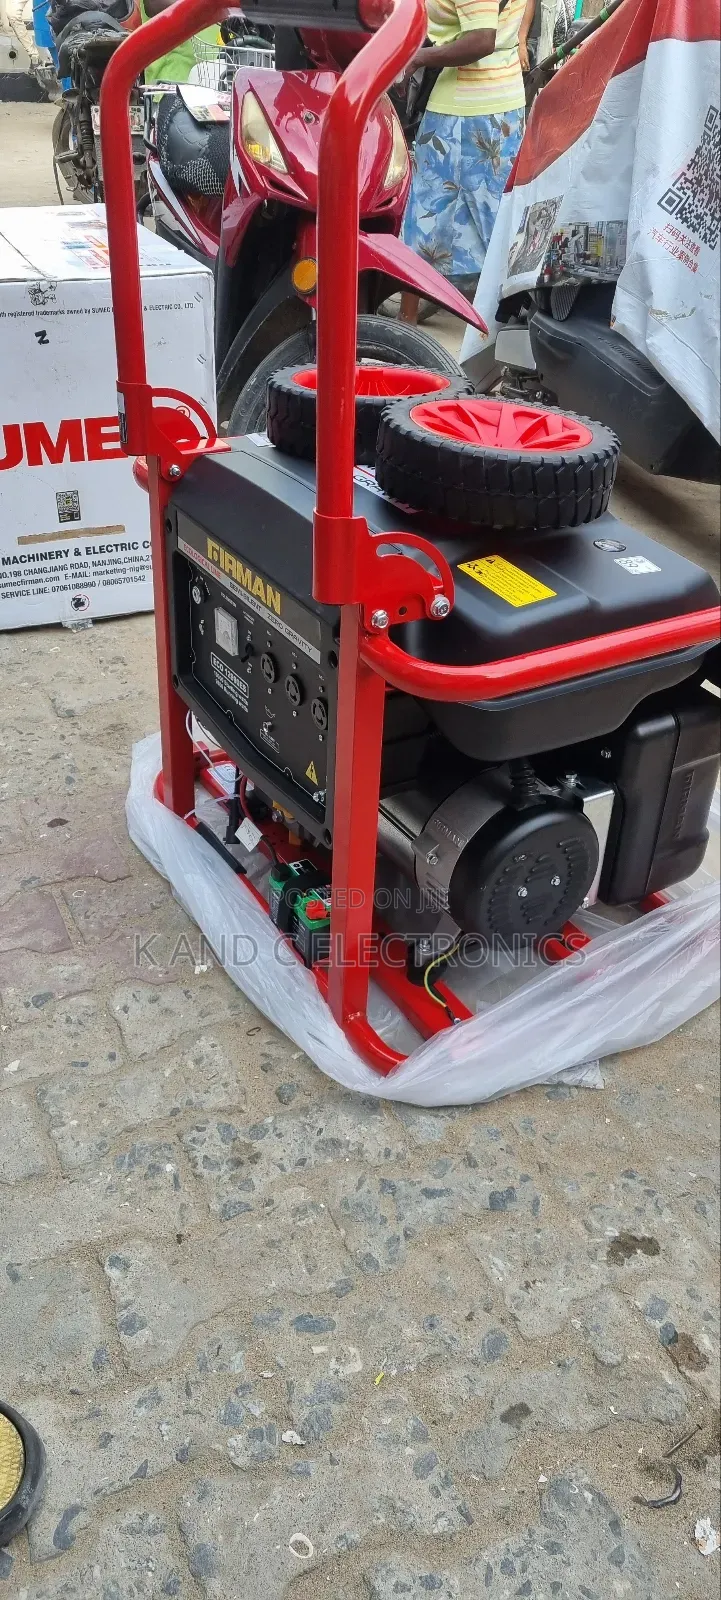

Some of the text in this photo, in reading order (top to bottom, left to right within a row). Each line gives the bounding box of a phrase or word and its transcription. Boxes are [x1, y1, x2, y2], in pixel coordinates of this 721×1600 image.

[1, 540, 152, 566] MACHINERY & ELECTRIC C
[23, 563, 69, 576] CHANGJIANG
[69, 561, 91, 570] ROAD,
[64, 571, 91, 580] E-MAIL:
[206, 537, 281, 615] FIRMAN
[1, 589, 31, 599] SERVICE
[32, 586, 50, 595] LINE:
[267, 613, 284, 630] ZERO
[284, 627, 313, 653] GRAVITY
[213, 656, 224, 672] ECO
